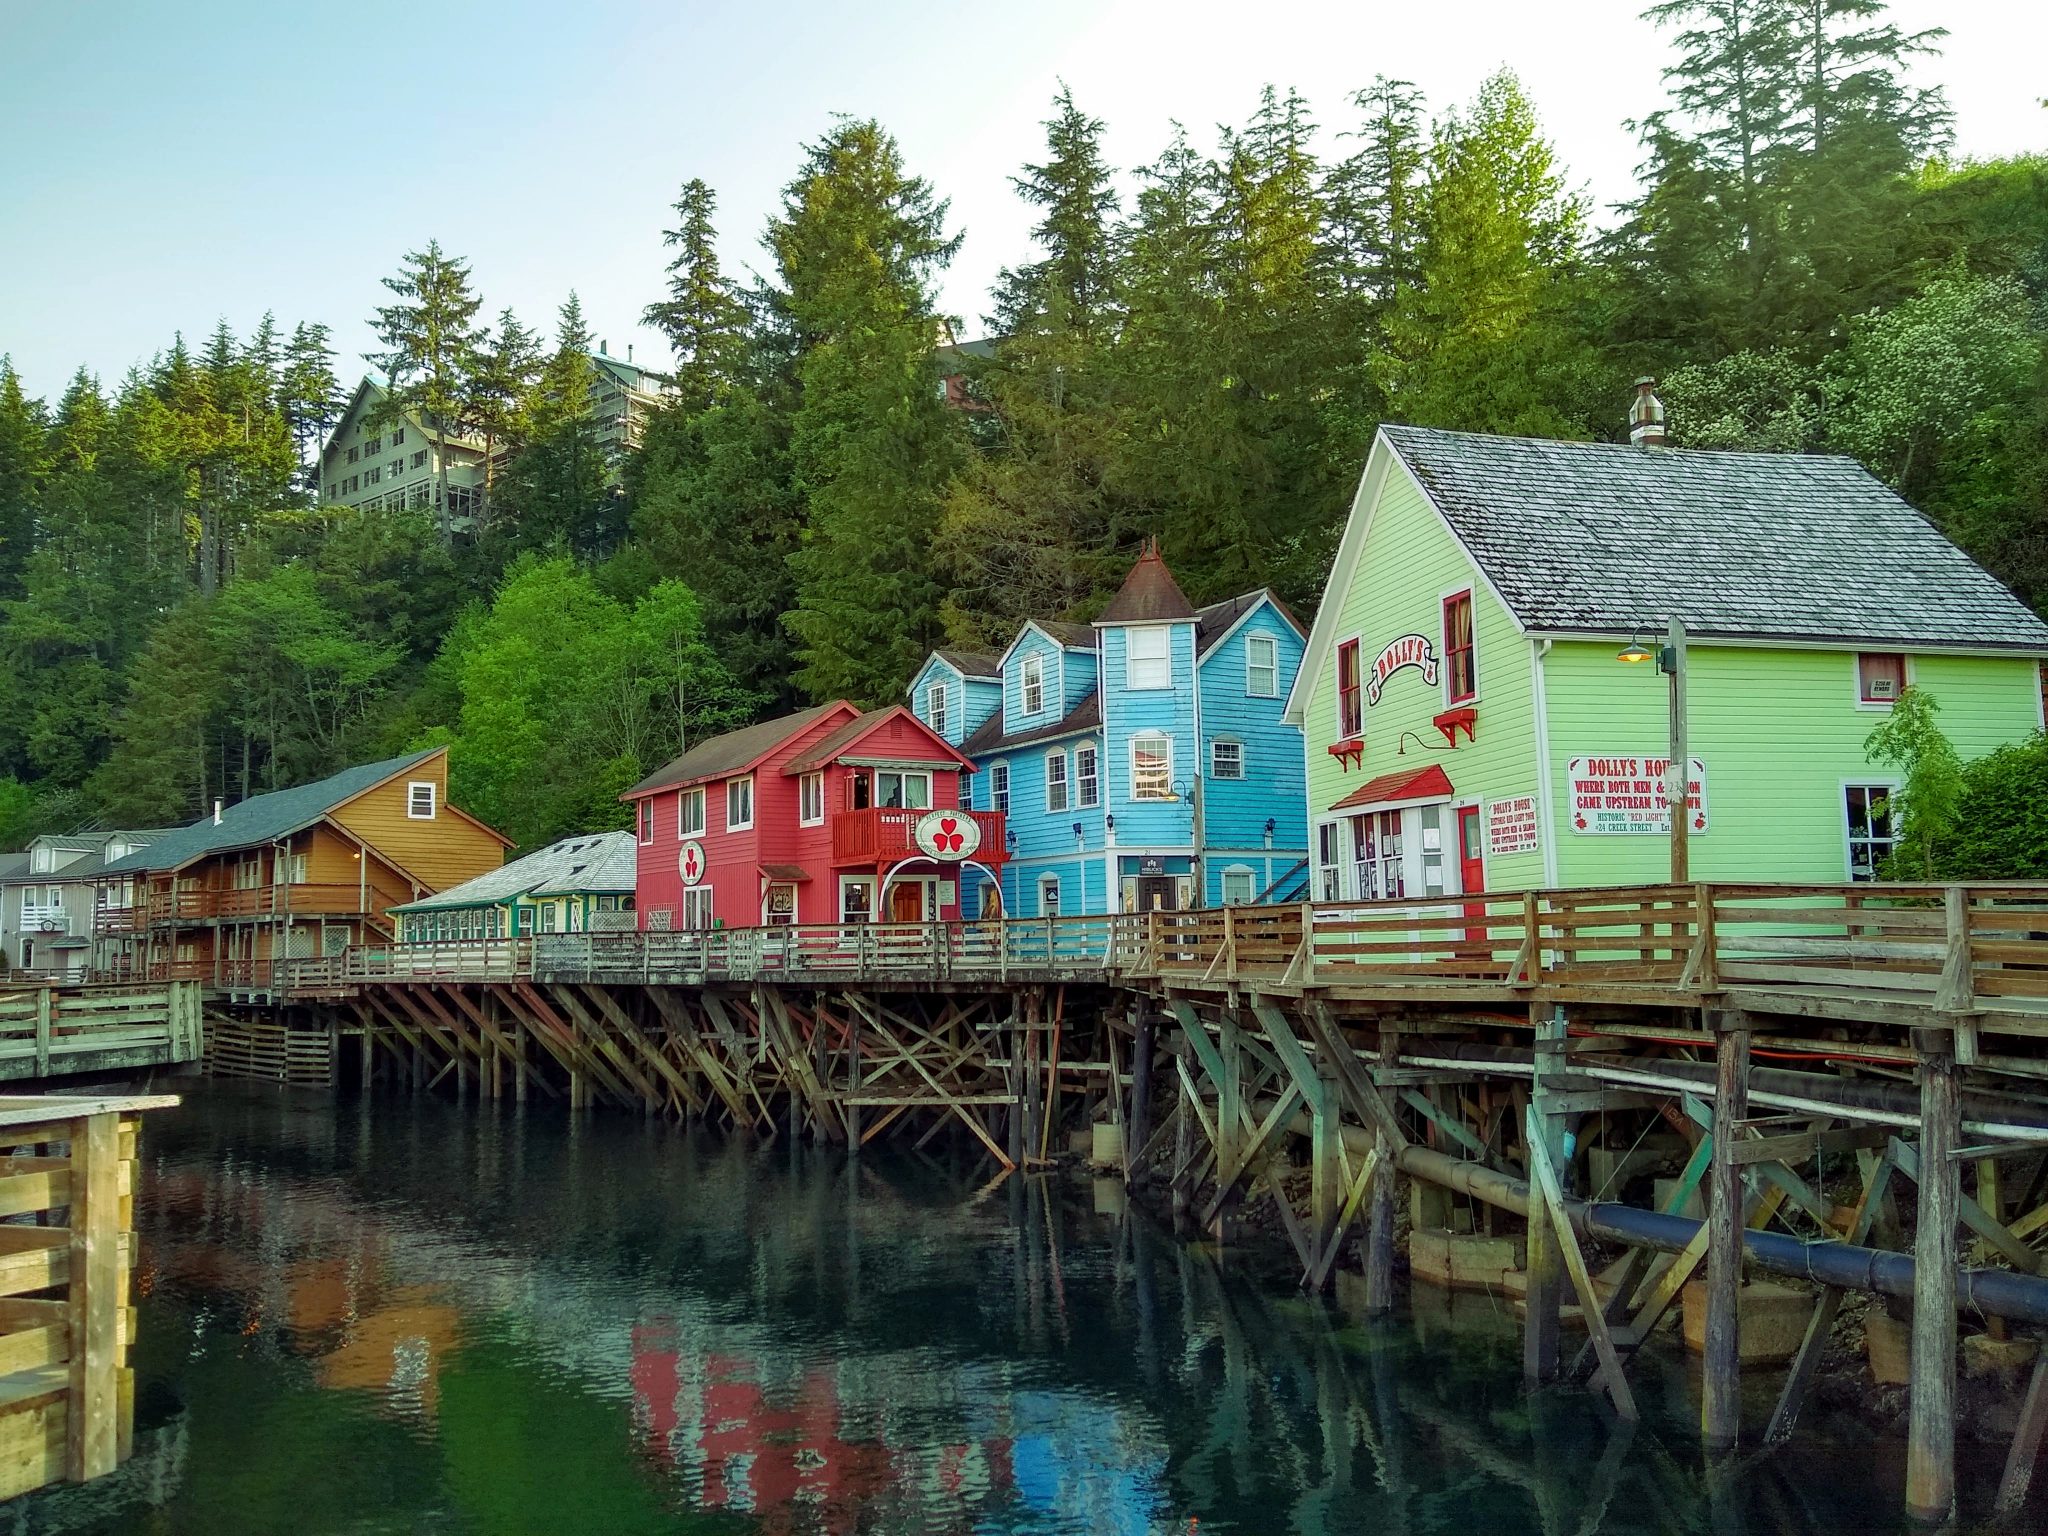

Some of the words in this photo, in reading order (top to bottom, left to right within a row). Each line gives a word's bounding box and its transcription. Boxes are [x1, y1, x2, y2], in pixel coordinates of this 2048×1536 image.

[1378, 637, 1424, 679] DOLLY'S
[1588, 758, 1638, 777] DOLLY'S
[1575, 780, 1605, 794] WHERE
[1608, 780, 1631, 794] BOTH
[1633, 780, 1652, 794] MEN
[1656, 780, 1665, 794] &
[1493, 801, 1511, 814] DOLLY'S
[1514, 798, 1530, 811] HOUSE
[1577, 796, 1602, 810] CAME
[1605, 796, 1652, 810] UPSTREAM
[1655, 796, 1667, 810] TO
[1597, 812, 1625, 822] HISTORIC
[1608, 823, 1628, 832] CREEK
[1630, 823, 1653, 832] STREET
